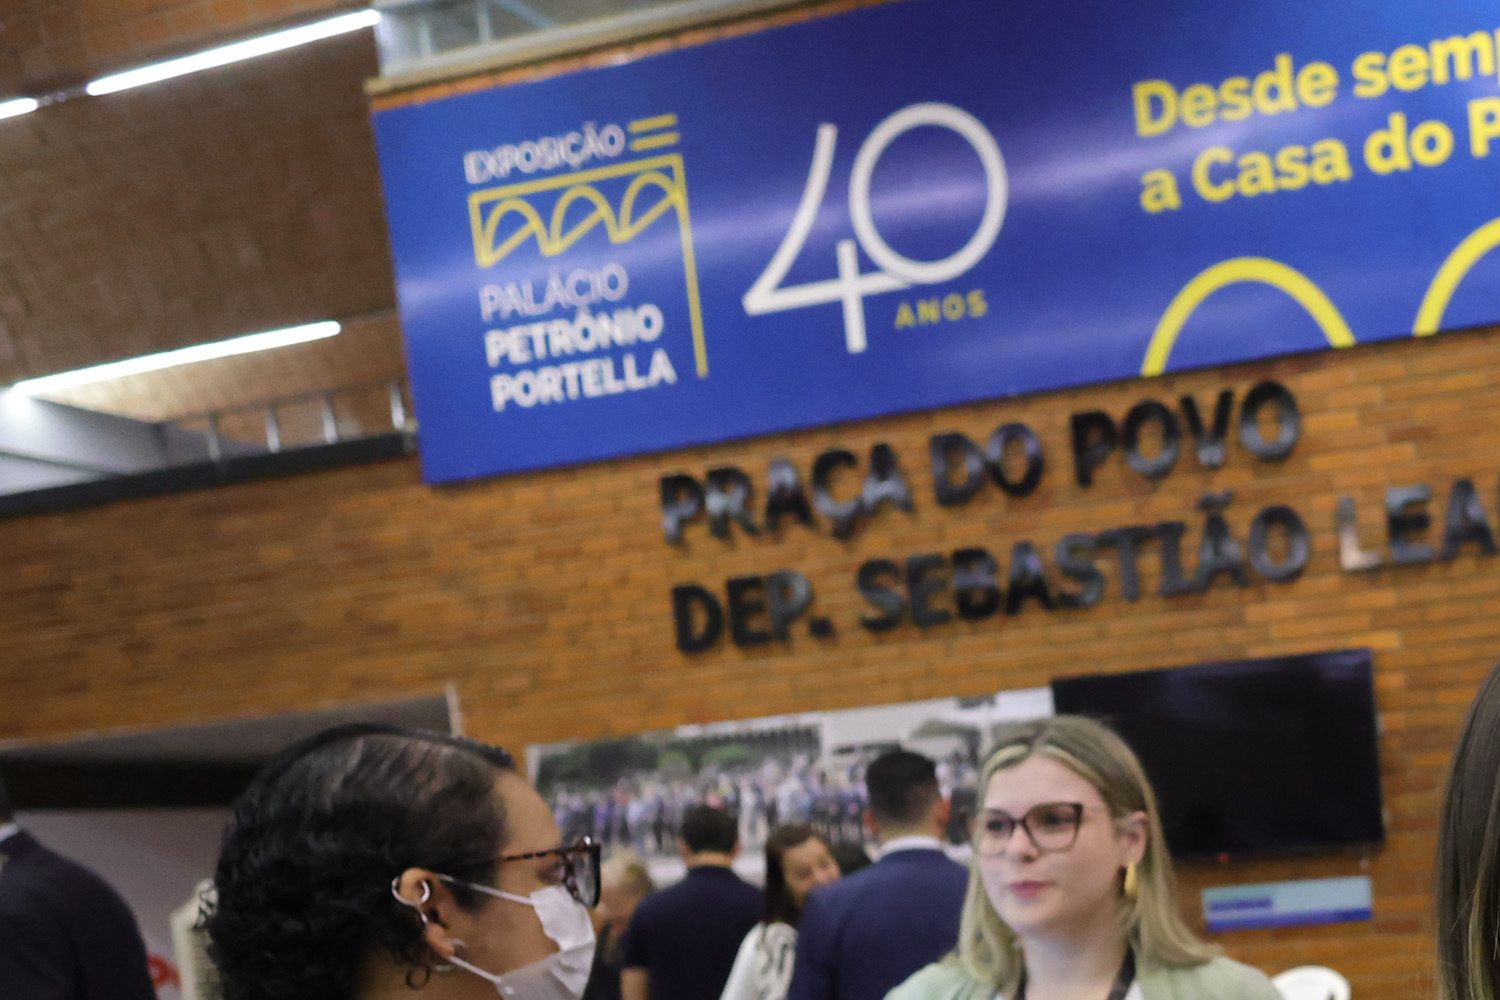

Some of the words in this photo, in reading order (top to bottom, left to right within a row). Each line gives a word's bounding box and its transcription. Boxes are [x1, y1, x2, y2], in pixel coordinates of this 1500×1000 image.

[1131, 53, 1339, 137] Desde
[464, 121, 626, 185] EXPOSIÇÃO
[1139, 168, 1182, 214] a
[1192, 136, 1353, 202] Casa
[1363, 111, 1454, 174] do
[743, 102, 1008, 354] 40
[479, 262, 629, 322] PALÁCIO
[895, 289, 988, 329] ANOS
[485, 303, 664, 368] PETRÔNIO
[490, 348, 678, 412] PORTELLA
[658, 443, 913, 545] PRAÇA
[931, 422, 1044, 506] DO
[1070, 380, 1301, 488] POVO
[671, 570, 833, 654] DEP.
[856, 490, 1310, 632] SEBASTIÃO
